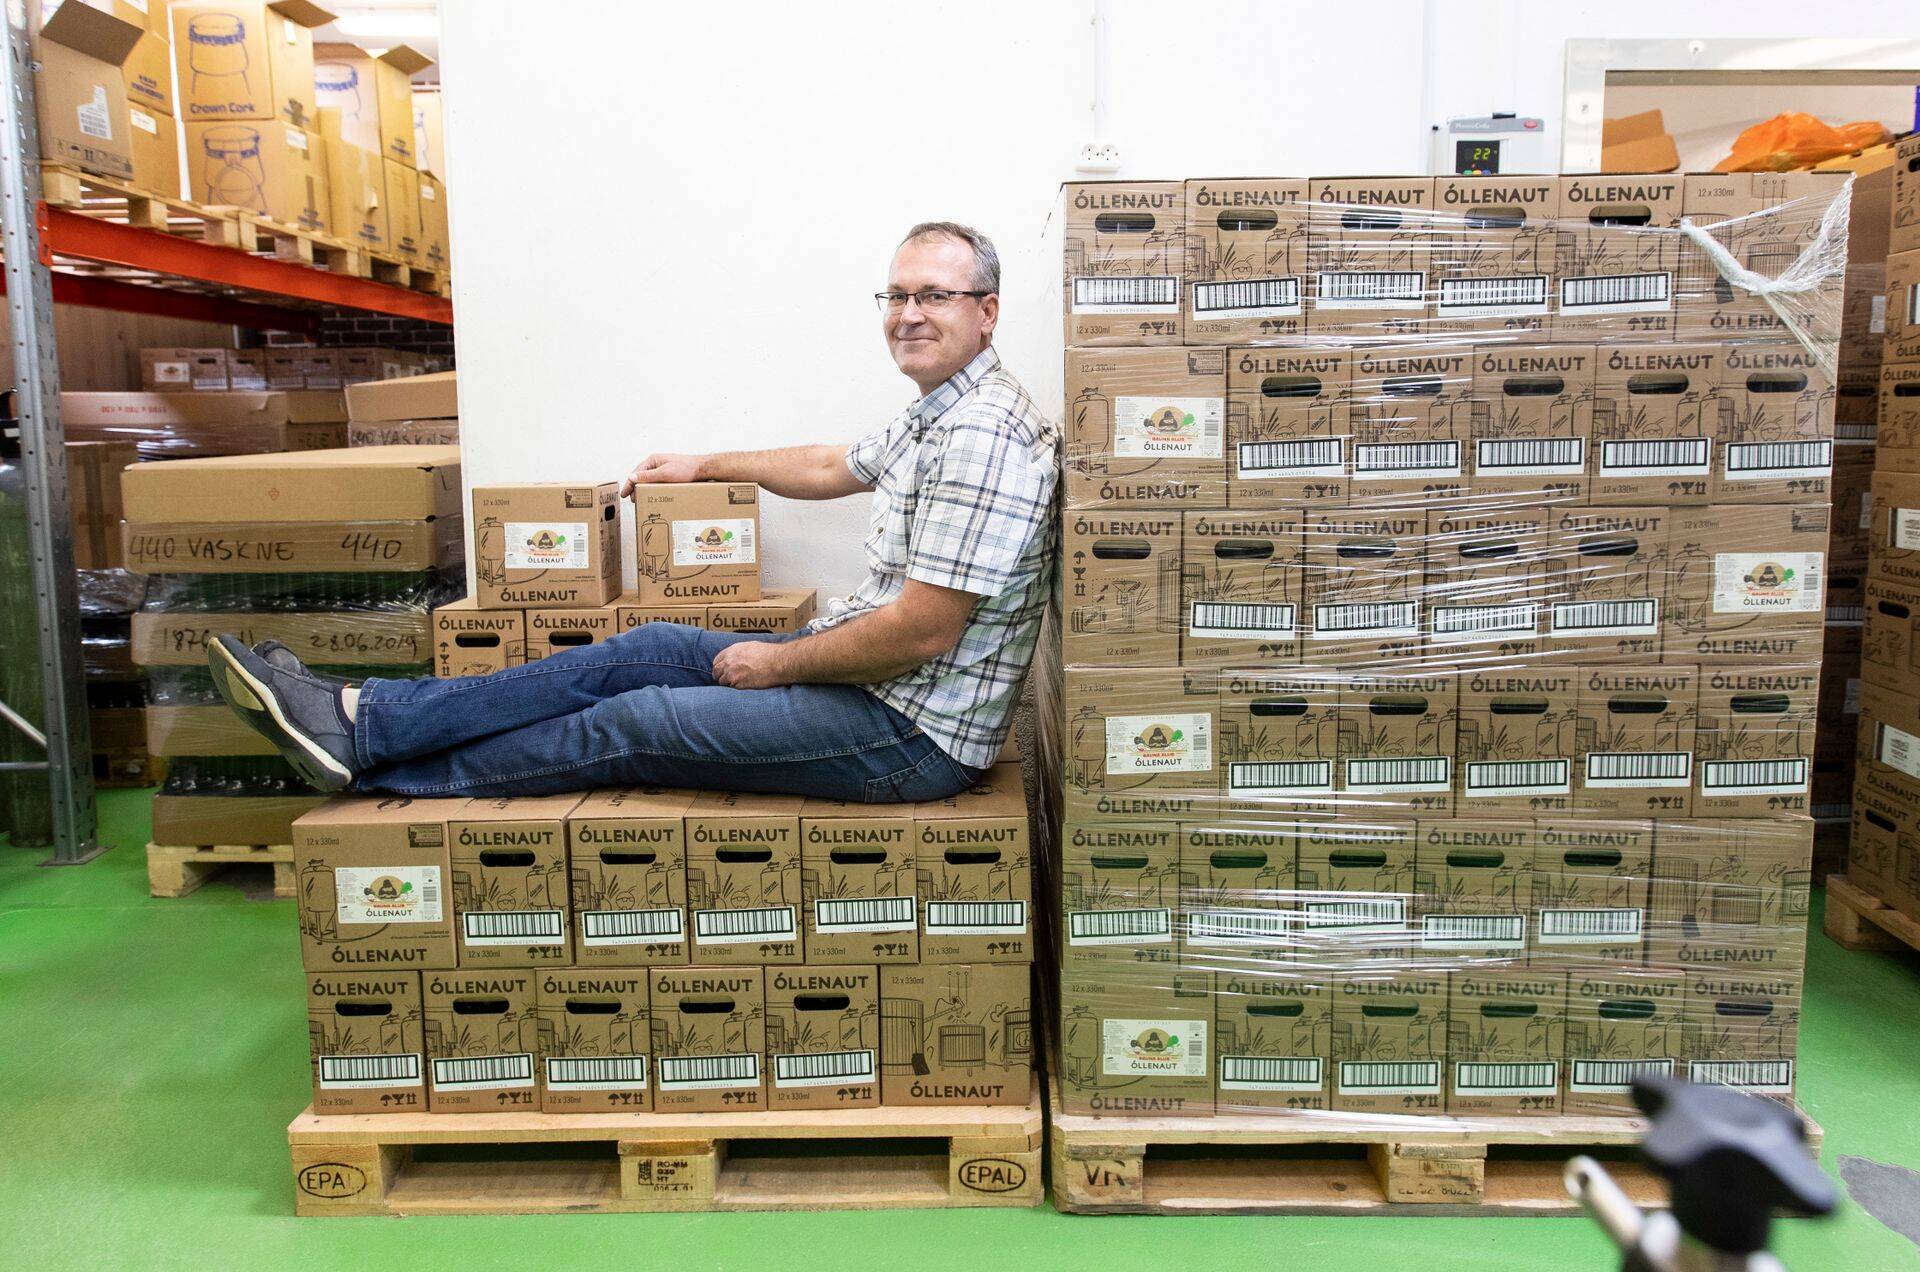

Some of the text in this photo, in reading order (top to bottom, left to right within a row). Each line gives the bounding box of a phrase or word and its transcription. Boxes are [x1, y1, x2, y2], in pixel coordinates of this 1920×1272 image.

[1473, 148, 1491, 160] 22
[1074, 190, 1176, 208] ÓLLENAUT
[1196, 186, 1299, 206] ÓLLENAUT
[1320, 186, 1424, 205] ÓLLENAUT
[1444, 183, 1549, 204] ÓLLENAUT
[1568, 182, 1674, 202] ÓLLENAUT
[1239, 354, 1342, 374] ÓLLENAUT
[1360, 354, 1463, 373] ÓLLENAUT
[1481, 354, 1585, 372] ÓLLENAUT
[1608, 352, 1714, 370] ÓLLENAUT
[1727, 350, 1816, 368] ÓLLENAU
[1144, 441, 1192, 450] ÓLLENAUT
[1074, 517, 1173, 536] ÓLLENAUT
[1317, 517, 1418, 536] ÓLLENAUT
[1559, 514, 1660, 532] ÓLLENAUT
[128, 533, 402, 563] 440 VASKNE 440
[501, 587, 578, 602] ÓLLENAUT
[664, 584, 739, 598] ÓLLENAUT
[1744, 597, 1791, 605] ÓLLENAUT
[440, 615, 514, 630] ÓLLENAUT
[533, 614, 608, 630] ÓLLENAUT
[713, 614, 787, 628] ÓLLENAUT
[1470, 674, 1570, 692] ÓLLENAUT
[1588, 672, 1689, 691] ÓLLENAUT
[1711, 672, 1813, 690] ÓLLENAUT
[1135, 758, 1181, 766] ÓLLENAUT
[459, 828, 554, 846] ÓLLENAUT
[579, 825, 673, 842] ÓLLENAUT
[694, 825, 789, 842] ÓLLENAUT
[808, 826, 904, 843] ÓLLENAUT
[922, 826, 1017, 842] ÓLLENAUT
[1072, 829, 1169, 846] ÓLLENAUT
[1428, 828, 1526, 846] ÓLLENAUT
[366, 908, 412, 916] ÓLLENAUT
[332, 946, 427, 962] ÓLLENAUT
[1678, 946, 1776, 961] ÓLLENAUT
[312, 978, 408, 996] ÓLLENAUT
[430, 978, 526, 995] ÓLLENAUT
[544, 978, 638, 994] ÓLLENAUT
[657, 976, 753, 992] ÓLLENAUT
[774, 973, 868, 990] ÓLLENAUT
[1131, 1061, 1177, 1069] ÓLLENAUT
[911, 1082, 1004, 1098] ÓLLENAUT
[967, 1166, 1018, 1184] EPAL
